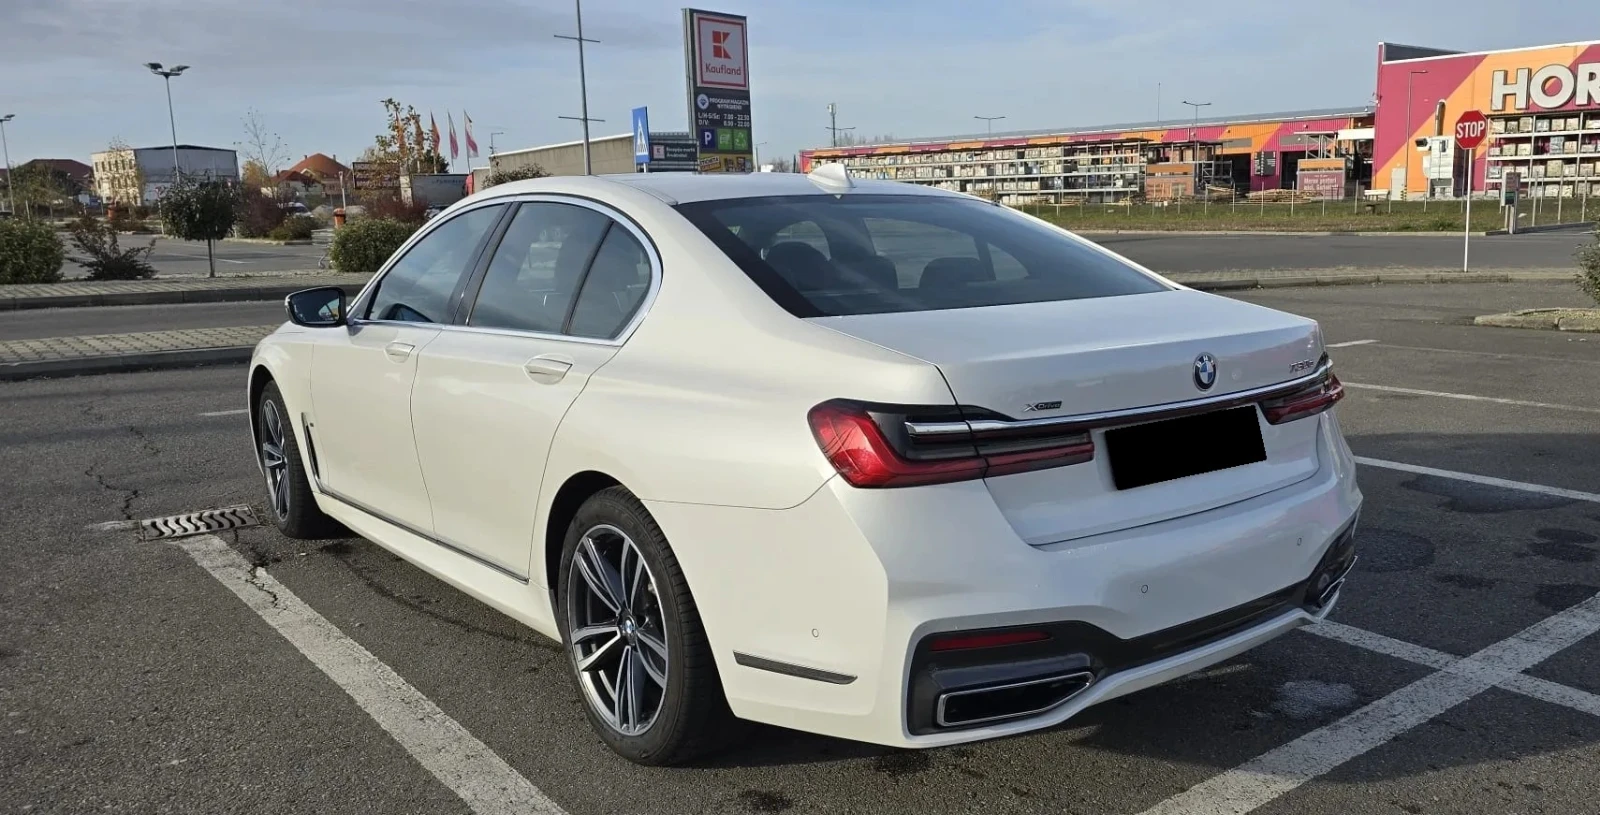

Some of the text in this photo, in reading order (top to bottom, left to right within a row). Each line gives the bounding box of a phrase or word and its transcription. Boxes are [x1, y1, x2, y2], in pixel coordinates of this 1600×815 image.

[706, 63, 741, 75] Kaufland
[1456, 121, 1485, 138] STOP
[704, 132, 712, 145] P
